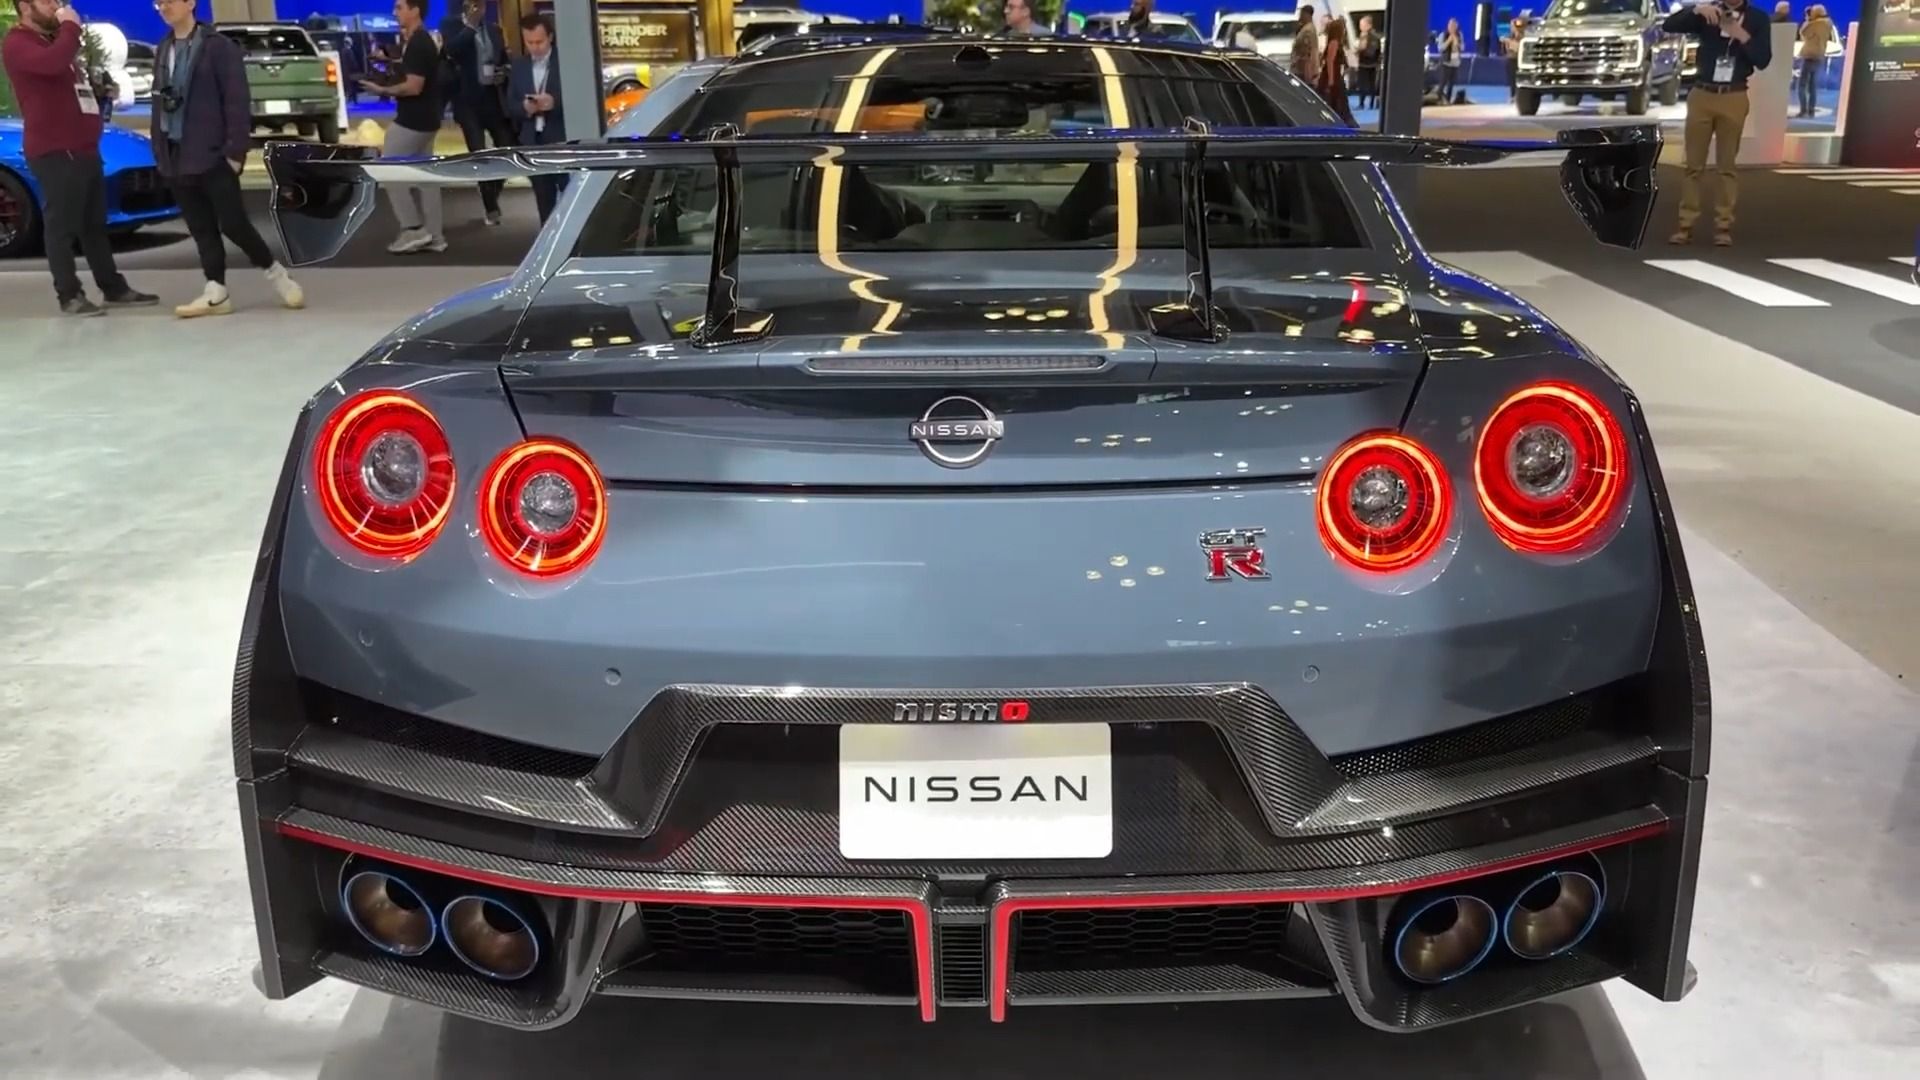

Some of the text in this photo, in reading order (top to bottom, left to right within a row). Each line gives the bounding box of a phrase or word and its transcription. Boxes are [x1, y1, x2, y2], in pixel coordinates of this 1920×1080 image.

[601, 36, 640, 47] PARK
[912, 424, 1002, 436] NISSAN
[894, 700, 1030, 722] nismo
[864, 774, 1088, 803] NISSAN
